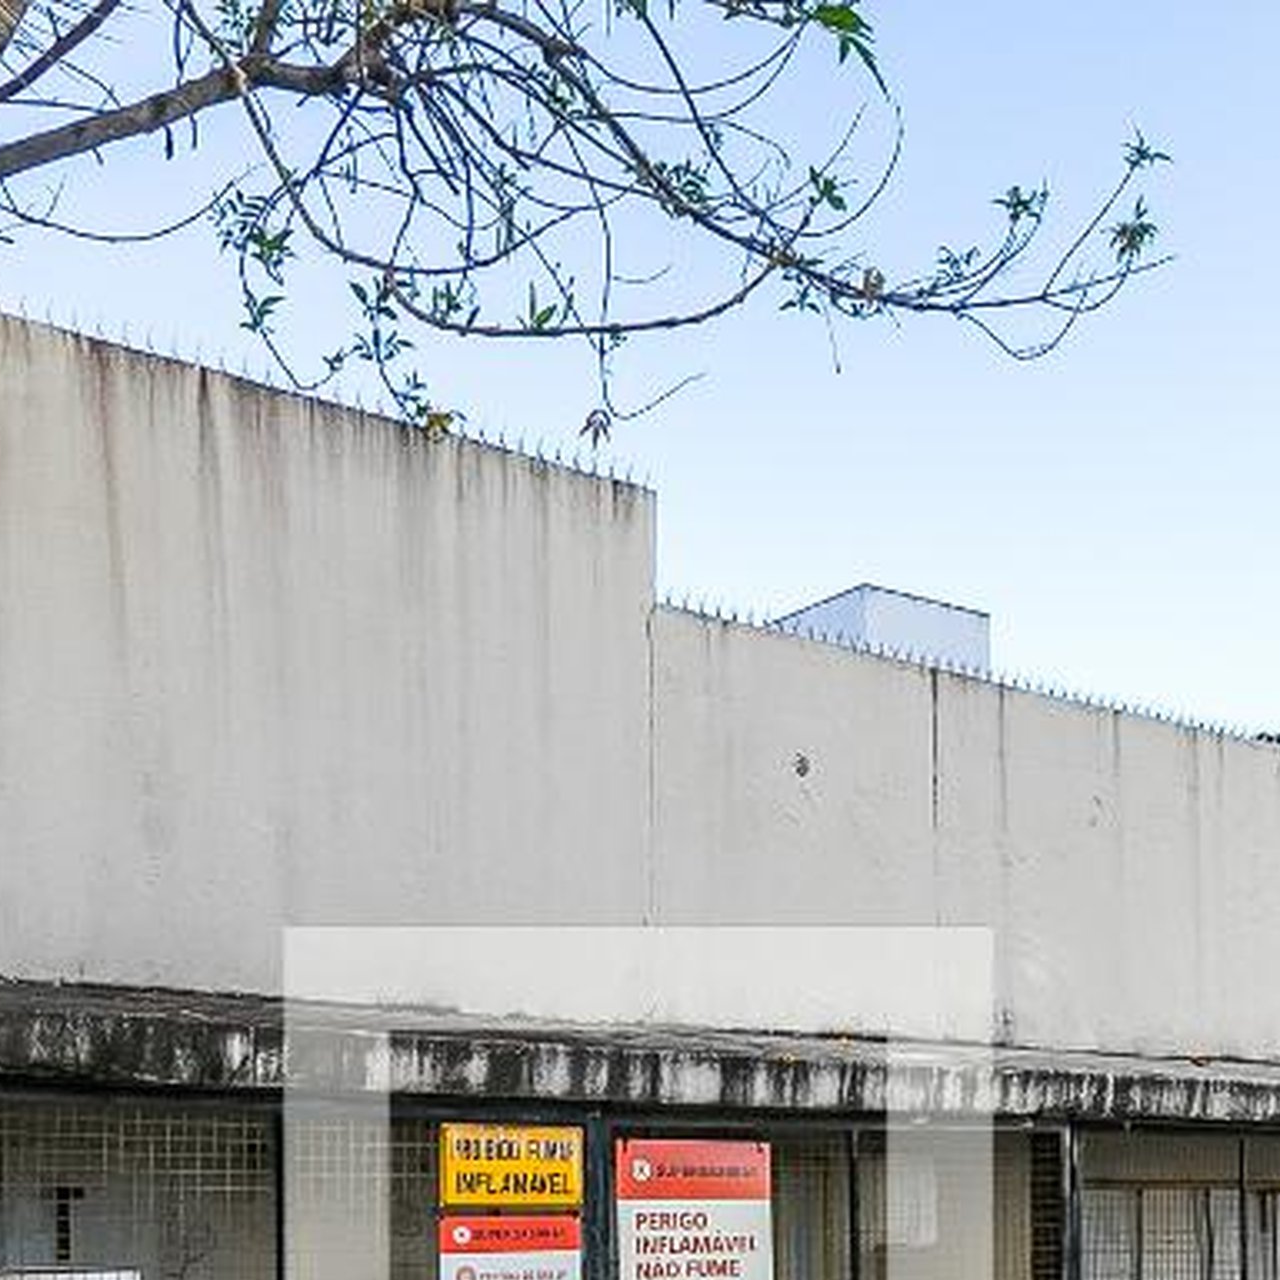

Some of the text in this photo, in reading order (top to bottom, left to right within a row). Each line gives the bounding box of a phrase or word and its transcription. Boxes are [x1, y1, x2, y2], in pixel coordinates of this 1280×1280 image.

[635, 1211, 709, 1231] PERIGO
[635, 1255, 741, 1280] NÃO FUME
